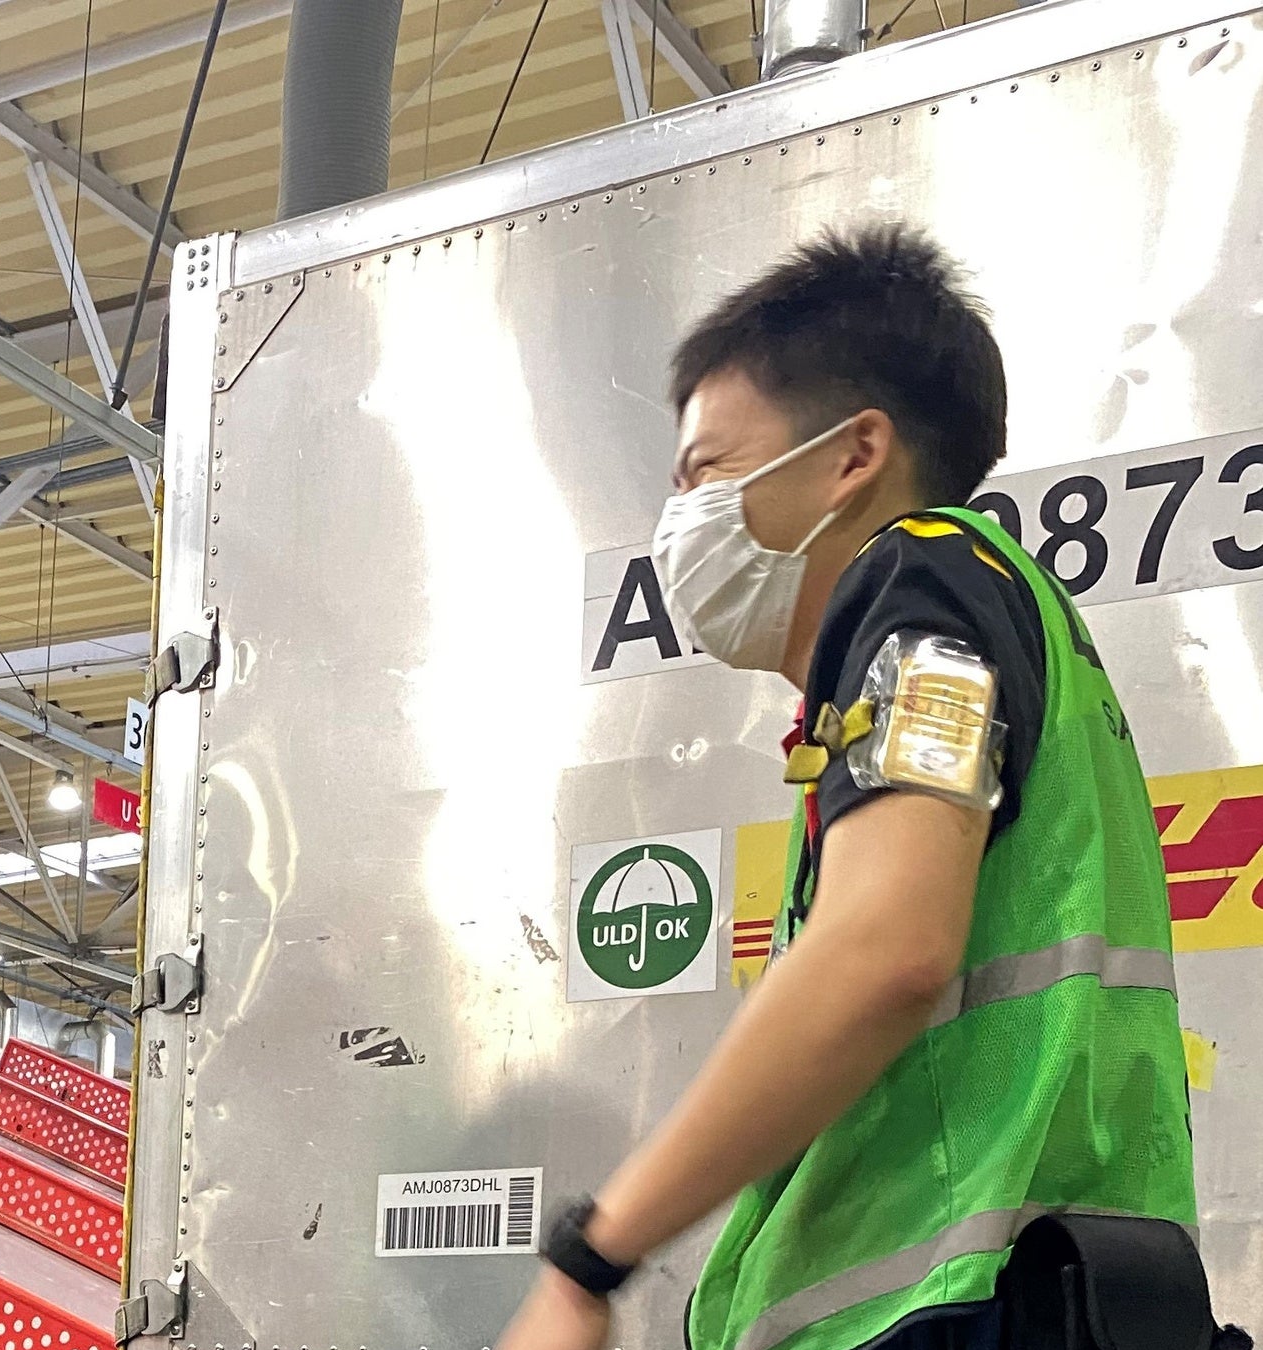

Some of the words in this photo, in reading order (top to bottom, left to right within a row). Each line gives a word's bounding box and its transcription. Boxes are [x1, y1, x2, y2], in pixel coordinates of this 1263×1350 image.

[591, 555, 704, 672] A
[129, 712, 148, 750] 3
[592, 923, 638, 947] ULD
[655, 916, 690, 941] OK
[401, 1177, 503, 1195] AMJ0873DHL
